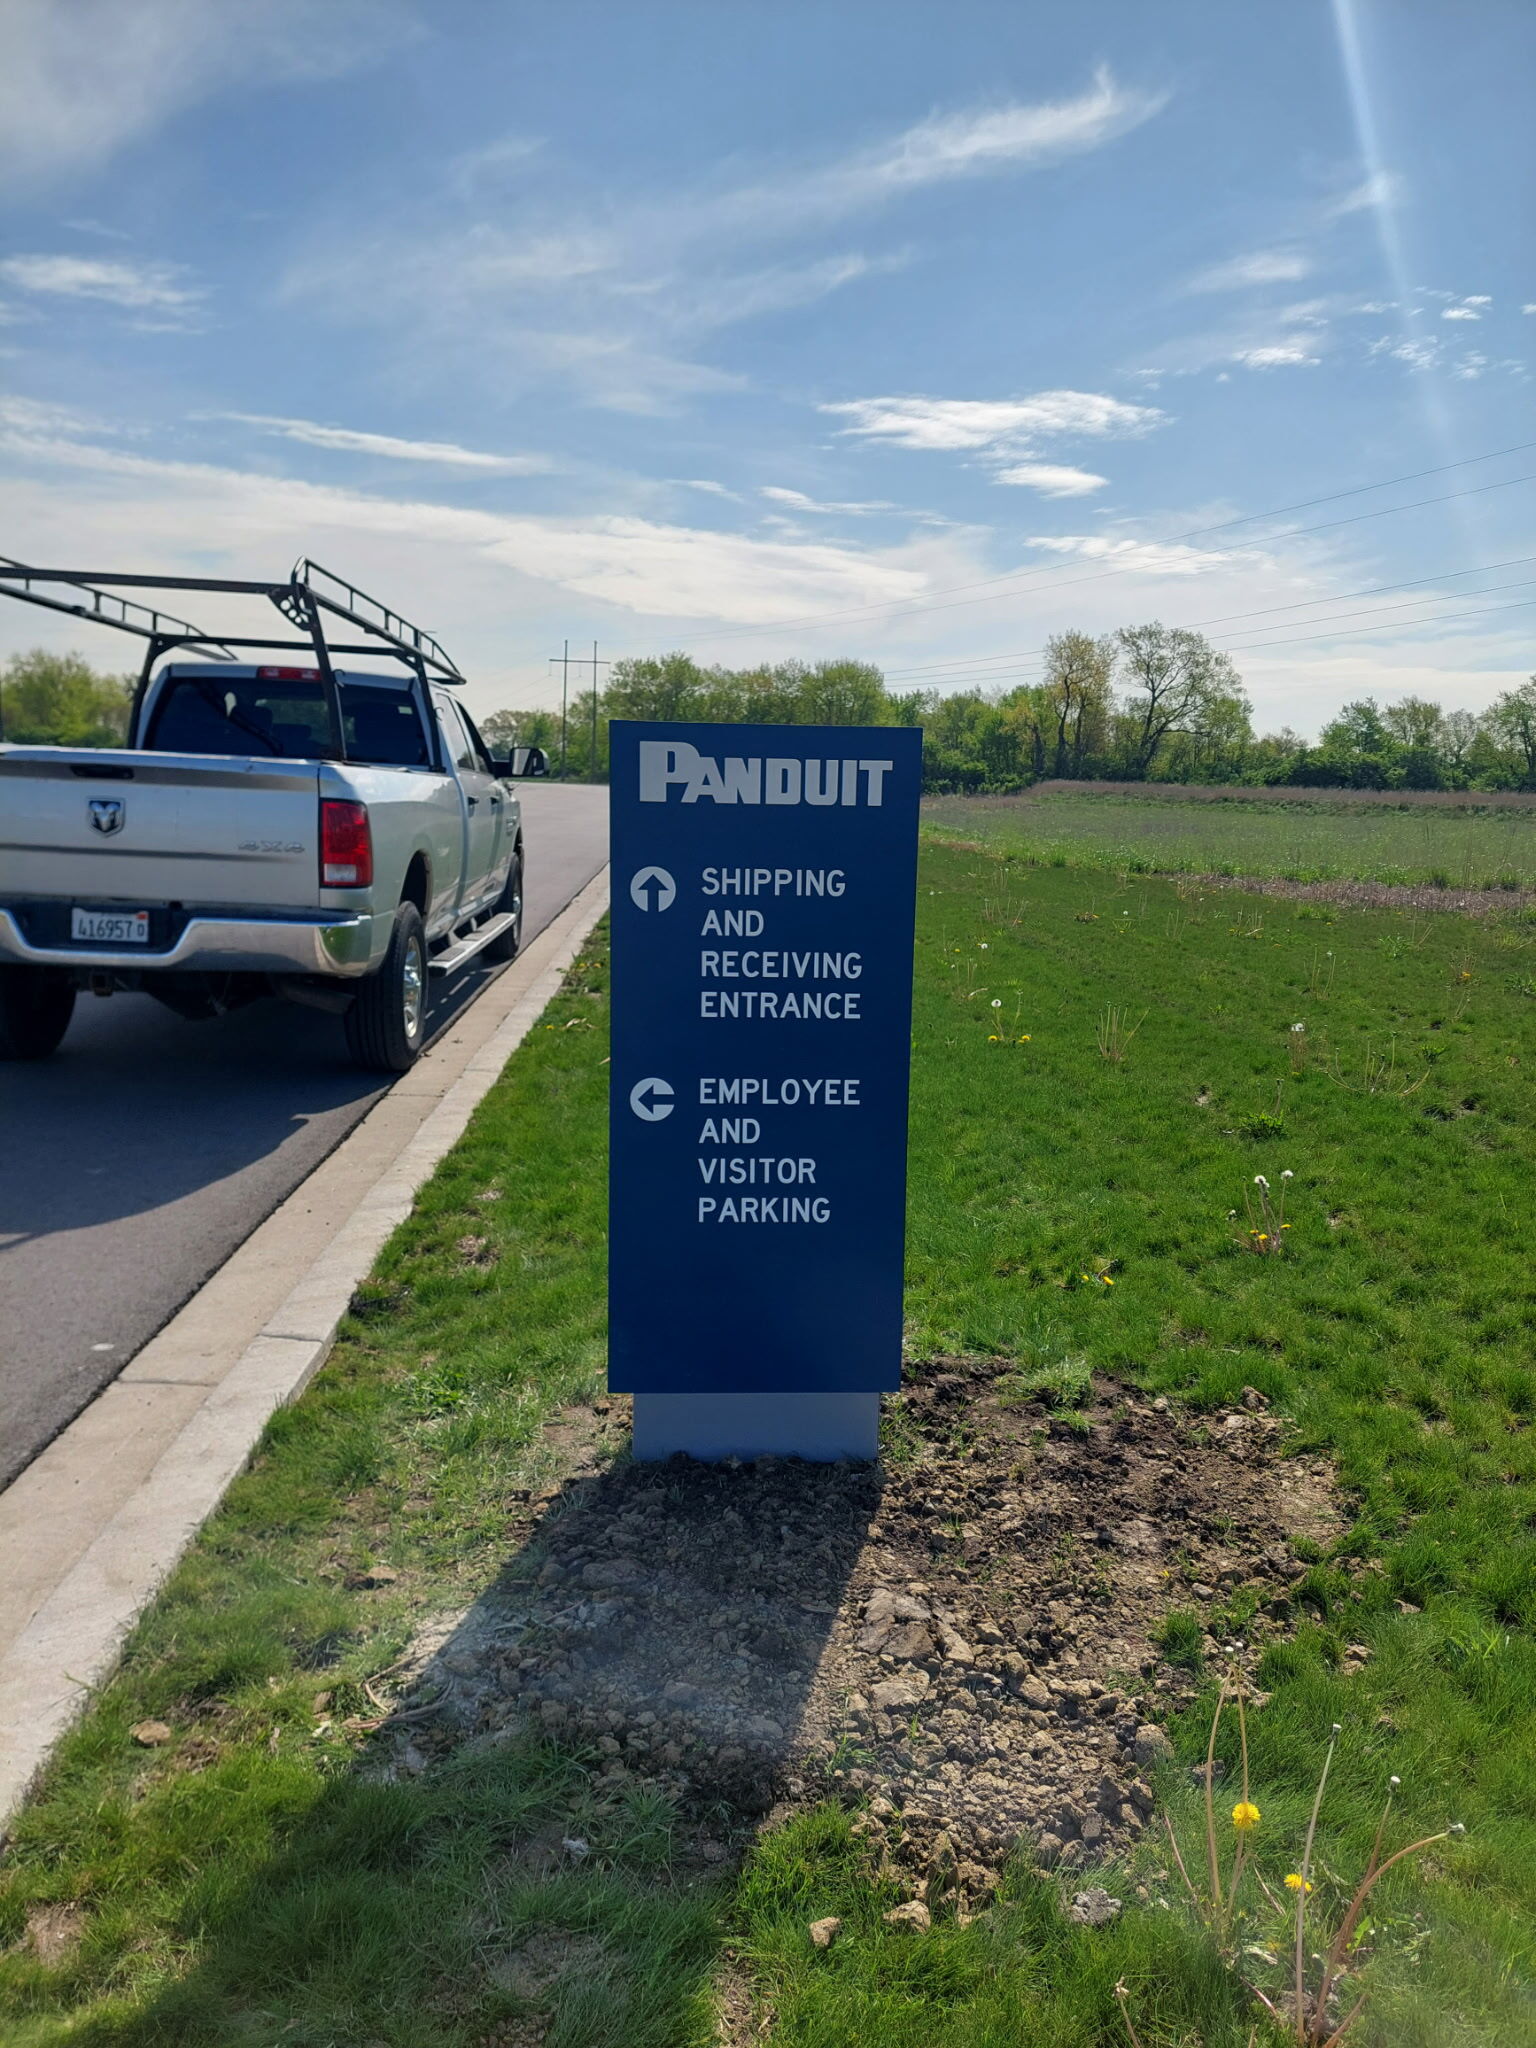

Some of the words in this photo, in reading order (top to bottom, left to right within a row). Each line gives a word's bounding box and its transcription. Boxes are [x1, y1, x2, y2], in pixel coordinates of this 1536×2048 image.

[639, 741, 893, 806] PANDUIT
[702, 867, 846, 897] SHIPPING
[78, 918, 132, 938] 416957
[701, 910, 764, 936] AND
[701, 951, 862, 979] RECEIVING
[701, 991, 861, 1019] ENTRANCE
[700, 1078, 860, 1105] EMPLOYEE
[698, 1118, 760, 1144] AND
[698, 1158, 816, 1184] VISITOR
[698, 1197, 831, 1223] PARKING
